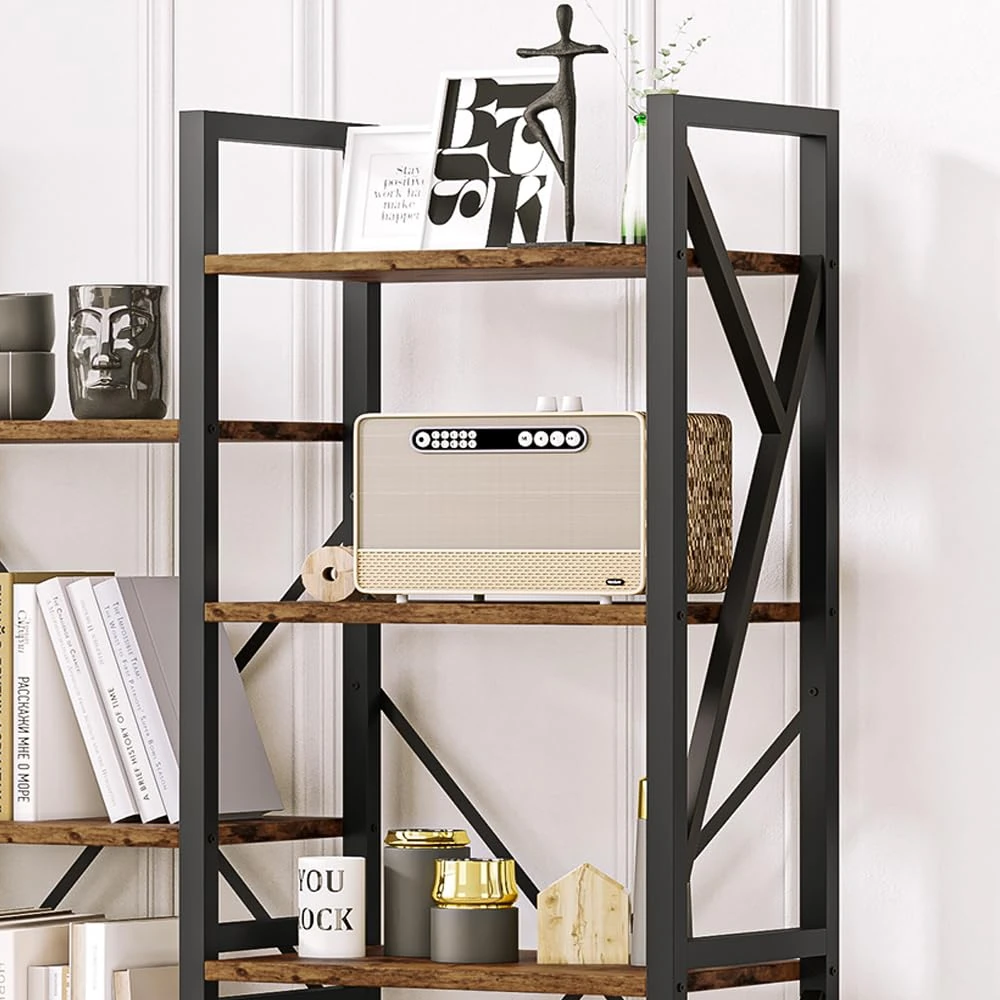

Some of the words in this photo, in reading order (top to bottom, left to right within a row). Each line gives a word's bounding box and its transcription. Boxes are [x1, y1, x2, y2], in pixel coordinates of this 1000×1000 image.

[17, 676, 30, 734] РАССКАЖИ
[107, 687, 118, 709] TIME
[114, 712, 124, 724] OF
[17, 737, 30, 760] МНЕ
[119, 727, 137, 764] HISTORY
[17, 773, 30, 803] МОРЕ
[133, 768, 147, 792] BRIEF
[143, 793, 150, 802] A
[298, 869, 345, 893] YOU
[299, 907, 354, 931] OCK
